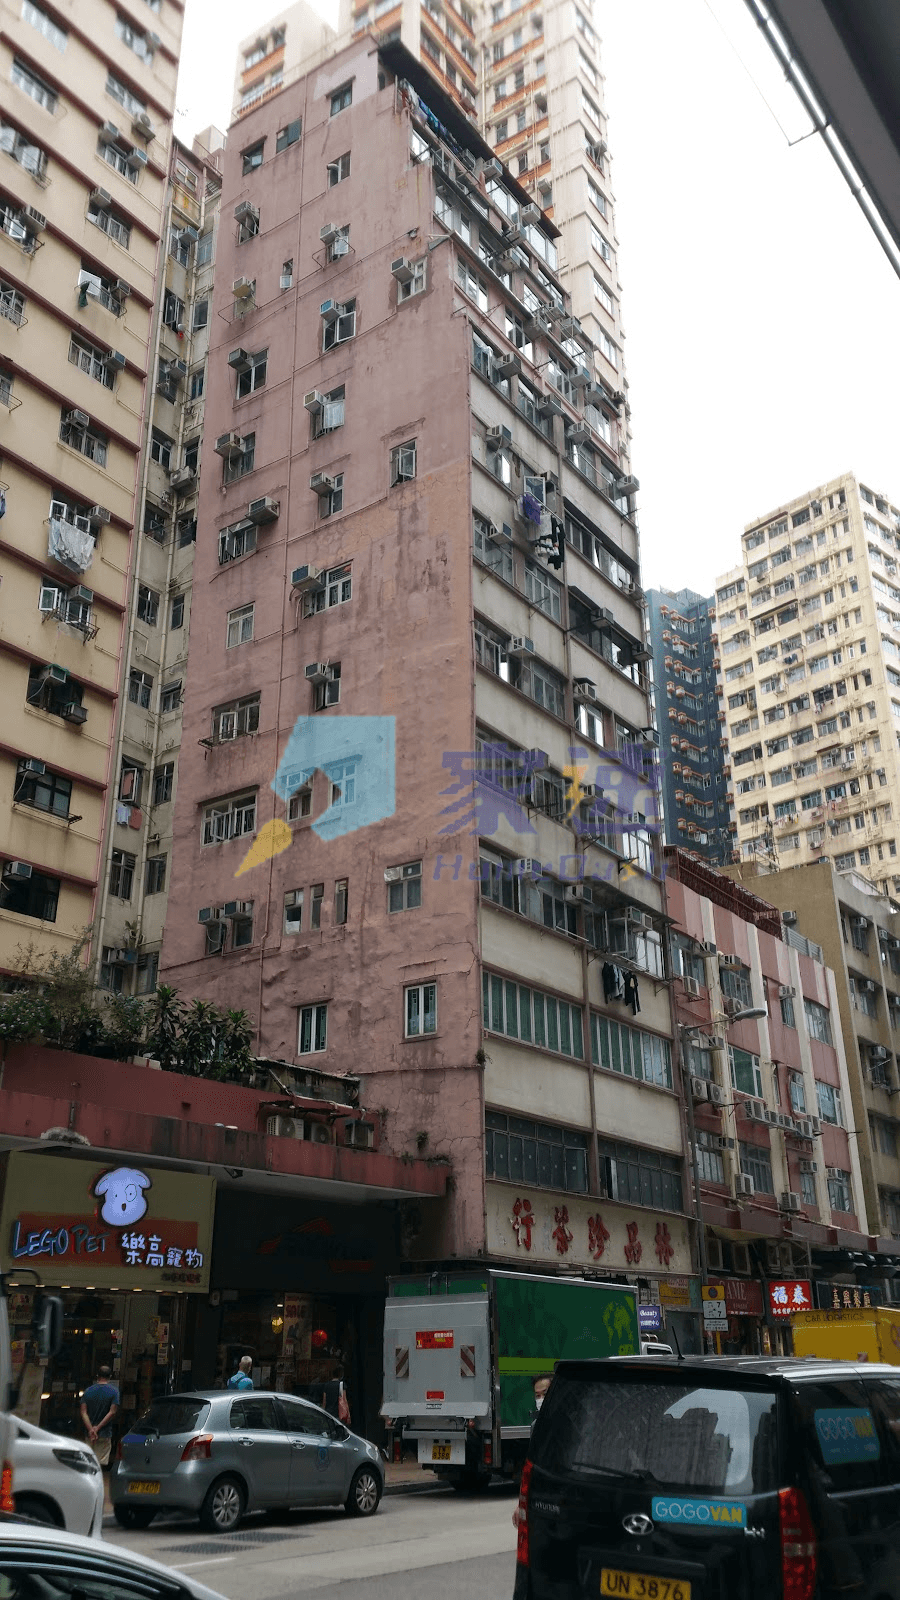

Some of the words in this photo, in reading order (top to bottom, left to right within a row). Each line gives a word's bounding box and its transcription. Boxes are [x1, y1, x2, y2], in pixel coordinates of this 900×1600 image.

[13, 1221, 69, 1258] LEGO
[71, 1223, 110, 1254] PET
[121, 1231, 204, 1268] 樂高寵物
[655, 1501, 743, 1524] GOGOVAN
[607, 1573, 630, 1594] UN
[635, 1577, 683, 1600] 3876
